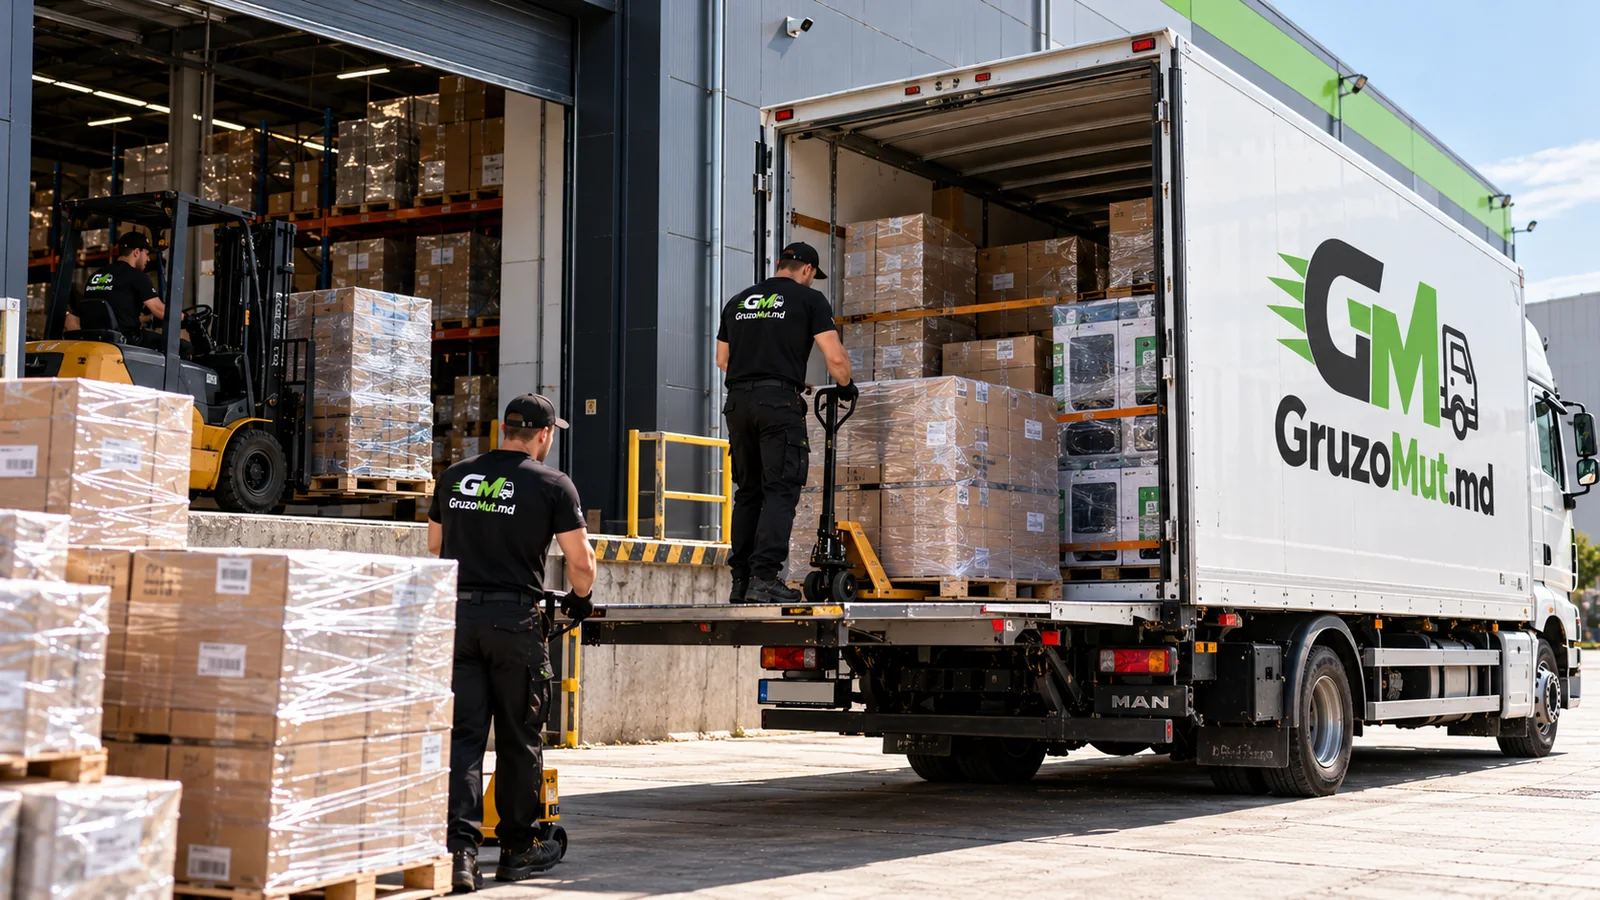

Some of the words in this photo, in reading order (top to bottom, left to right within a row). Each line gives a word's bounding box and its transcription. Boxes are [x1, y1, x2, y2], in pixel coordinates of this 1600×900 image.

[744, 293, 778, 310] GM
[1304, 237, 1441, 428] GM
[1274, 394, 1495, 516] GruzoMut.md
[459, 473, 507, 499] GM
[448, 497, 516, 515] GruzoMut.md
[1111, 695, 1169, 709] MAN
